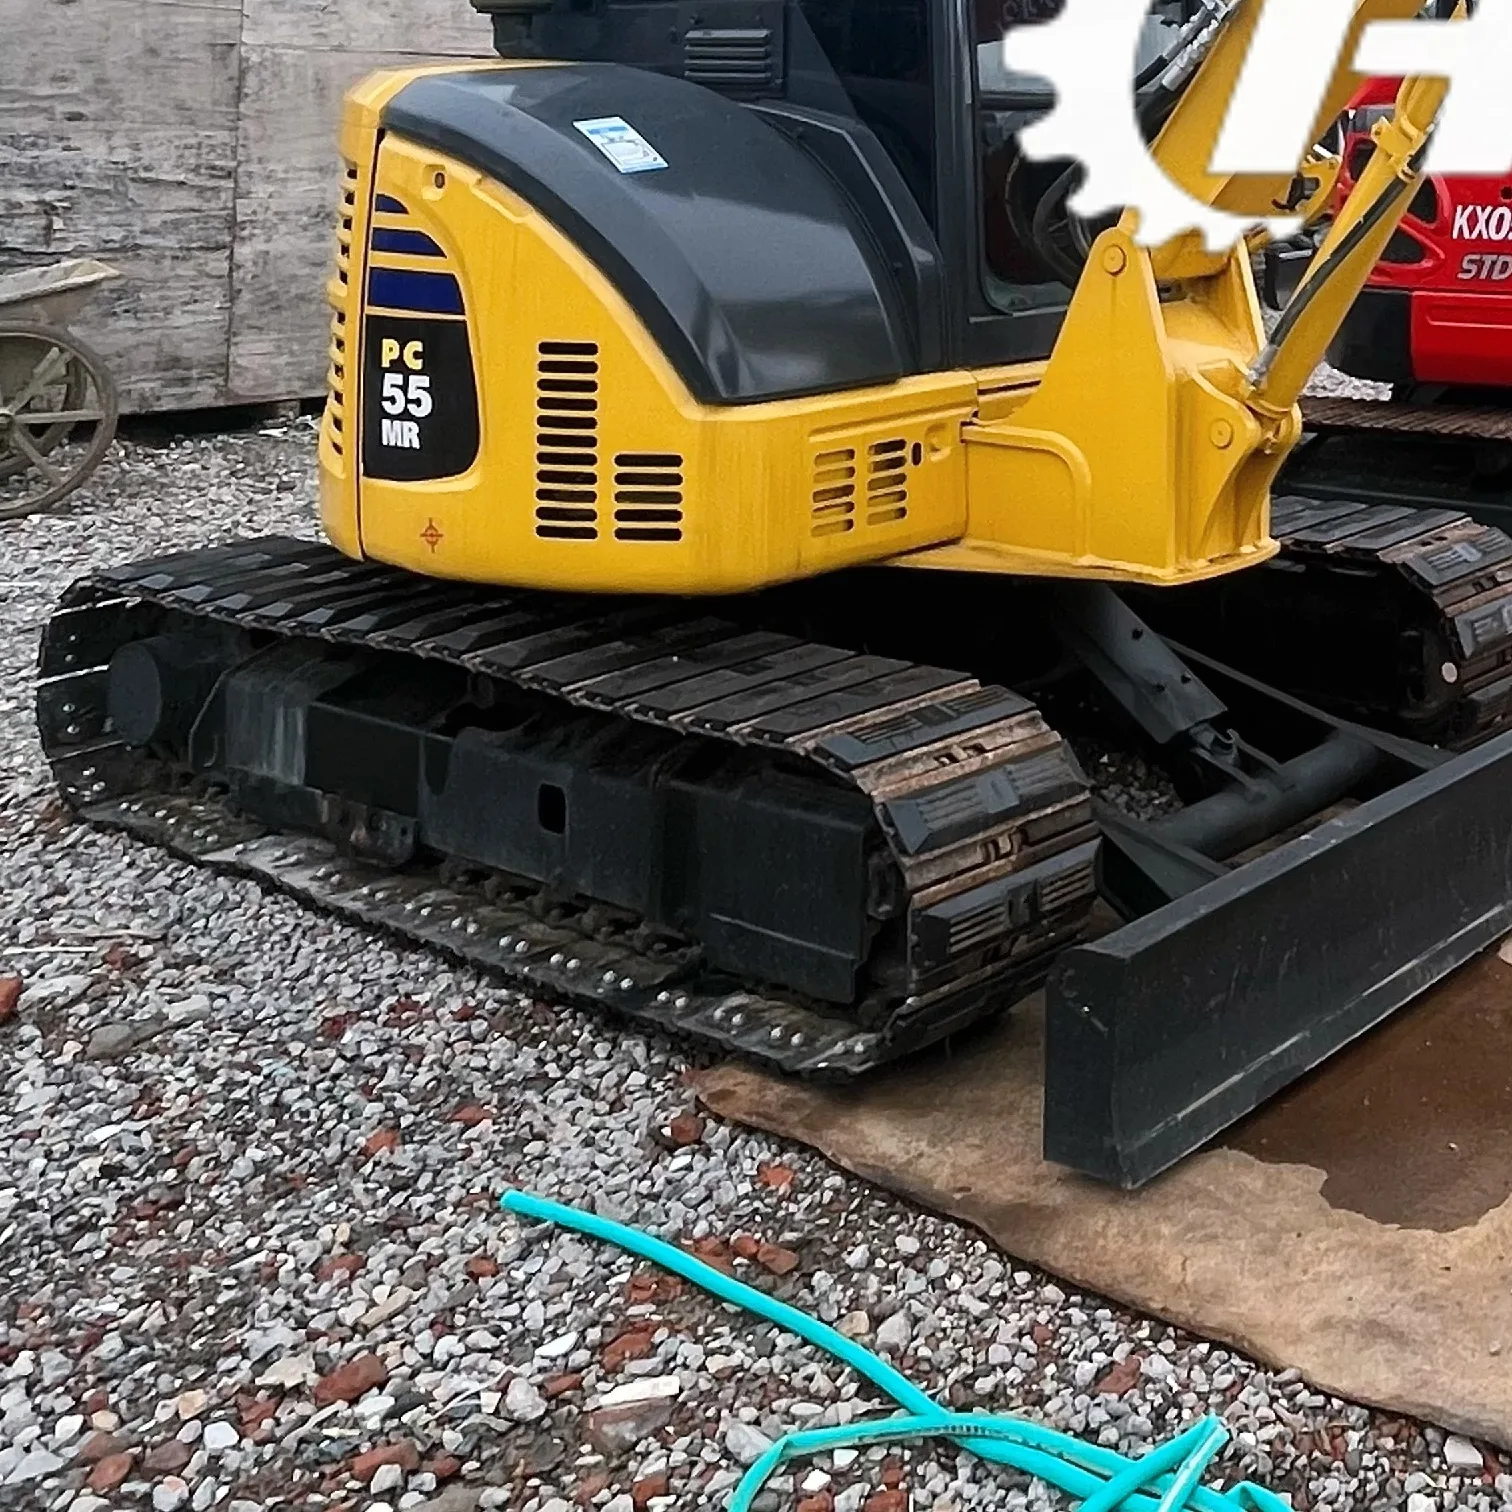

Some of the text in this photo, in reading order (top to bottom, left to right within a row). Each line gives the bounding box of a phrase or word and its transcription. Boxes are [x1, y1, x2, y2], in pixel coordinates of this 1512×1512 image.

[381, 338, 424, 370] PC
[381, 372, 433, 418] 55
[381, 418, 421, 450] MR
